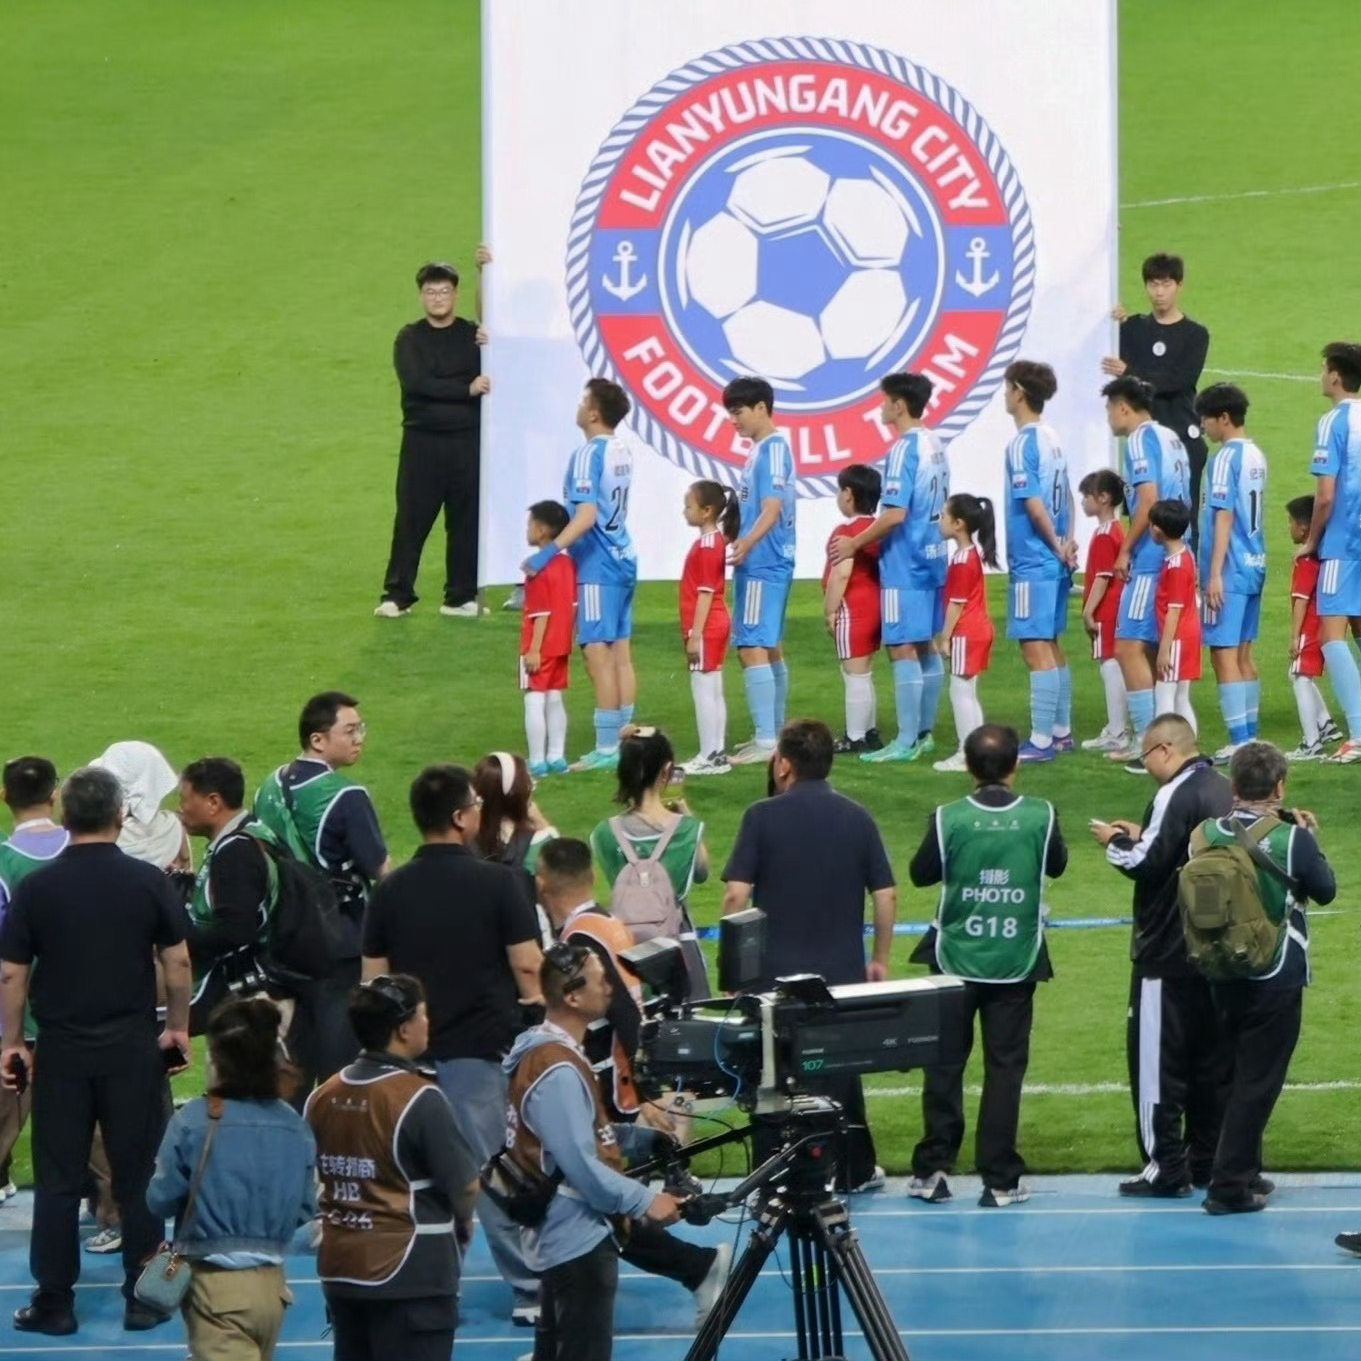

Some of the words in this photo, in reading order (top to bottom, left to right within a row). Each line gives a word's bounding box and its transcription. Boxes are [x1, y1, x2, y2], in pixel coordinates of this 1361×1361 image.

[620, 74, 919, 214] LIANYUNGANG
[910, 125, 990, 211] CITY
[622, 335, 852, 464] FOOTBLL
[862, 333, 980, 442] TAM
[979, 868, 1010, 886] 摄影
[962, 886, 1026, 904] PHOTO
[965, 915, 1018, 939] G18
